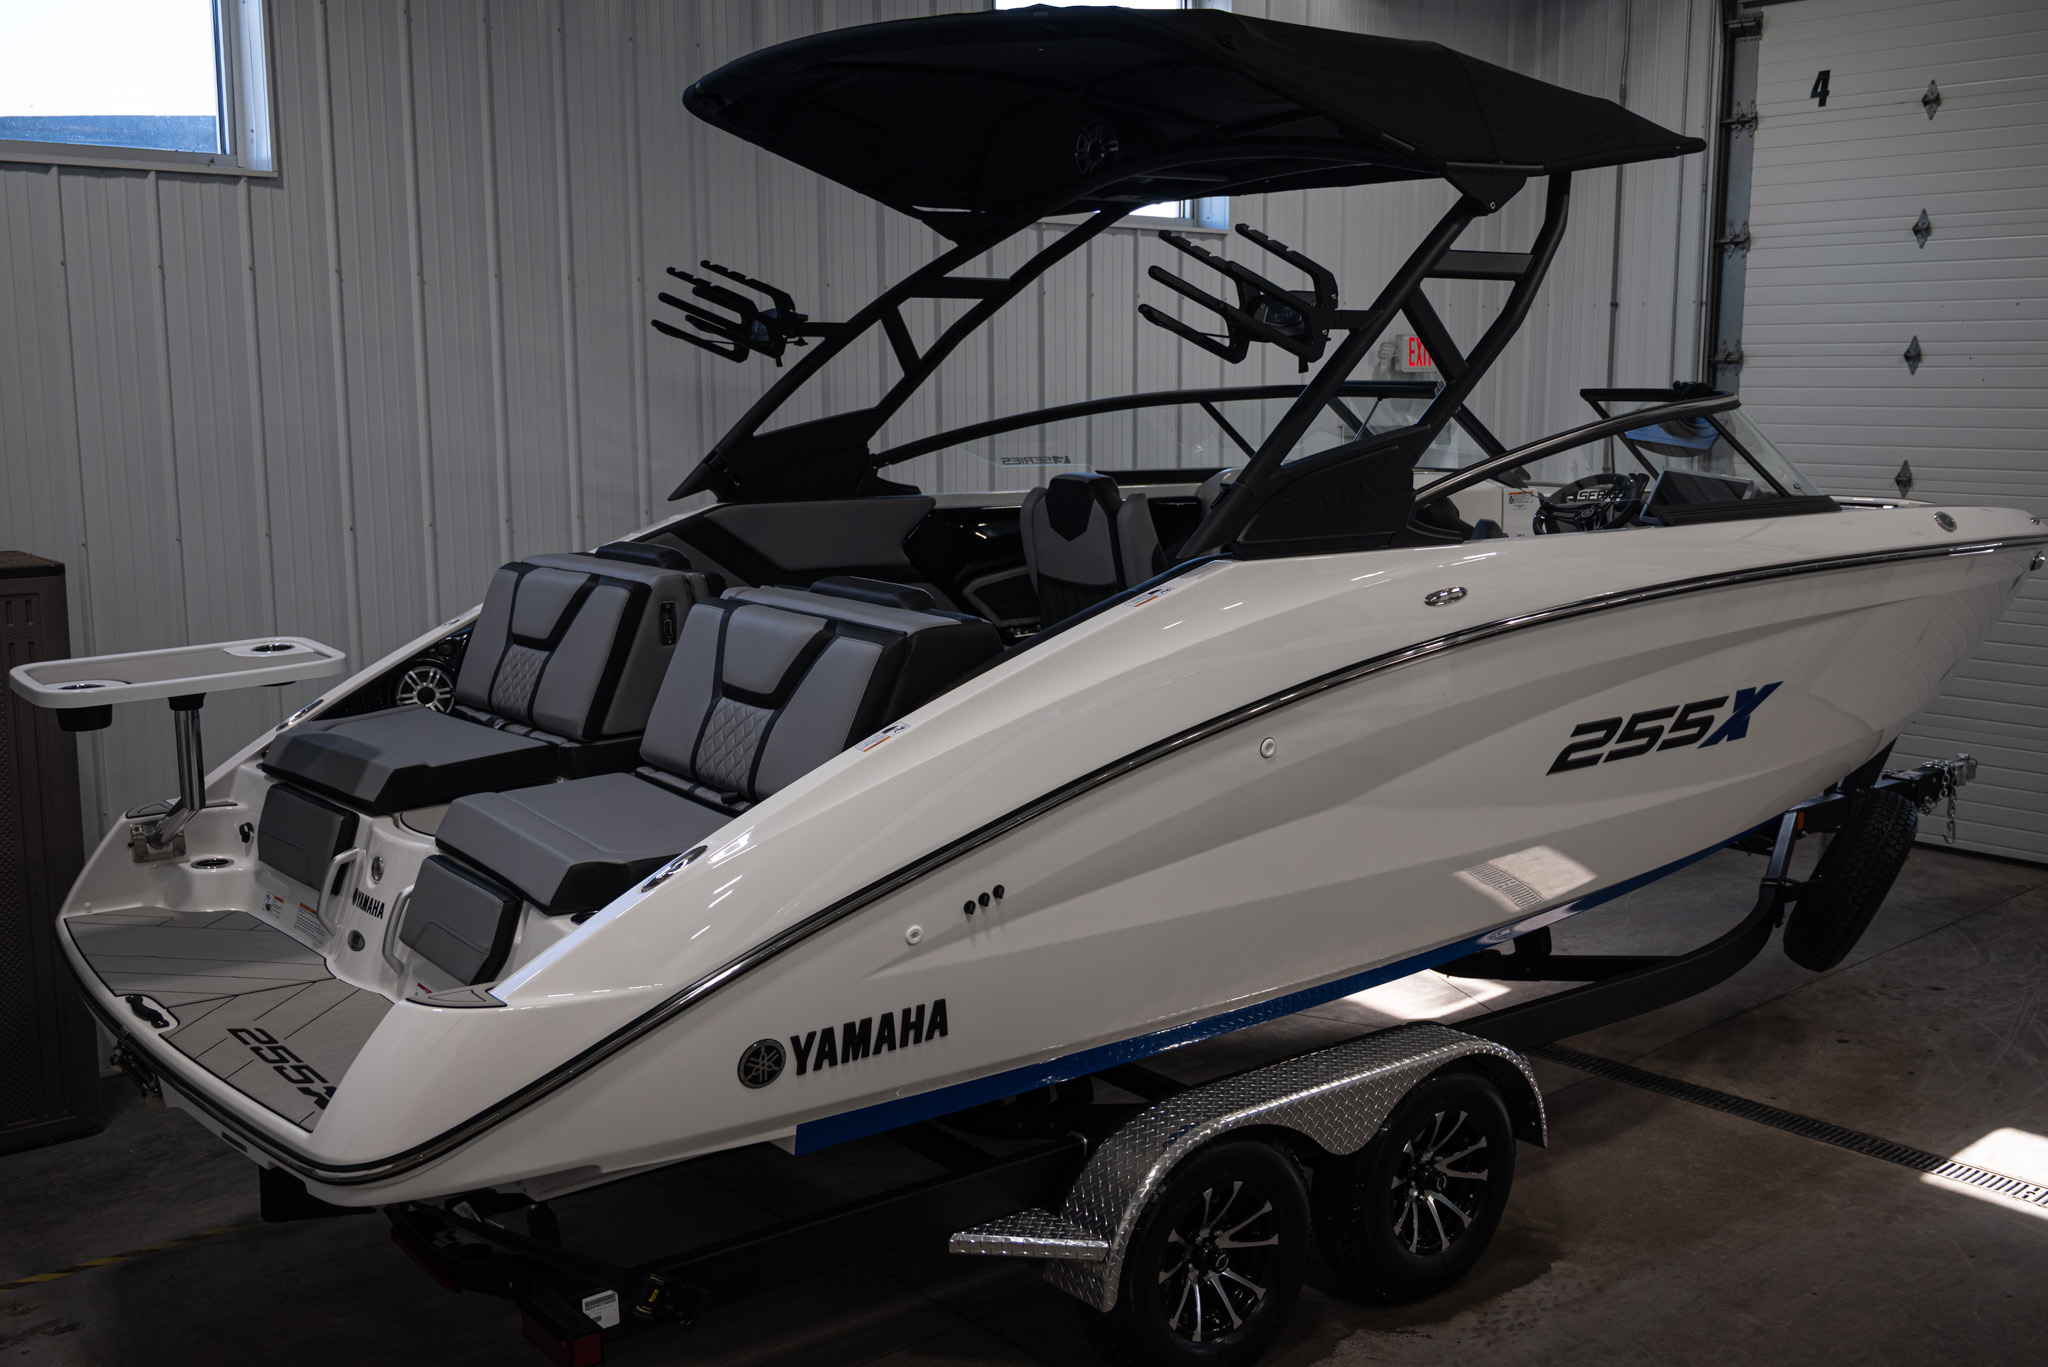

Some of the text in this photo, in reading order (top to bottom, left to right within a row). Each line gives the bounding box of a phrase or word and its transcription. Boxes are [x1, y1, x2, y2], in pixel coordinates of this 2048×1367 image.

[1810, 69, 1830, 107] 4
[1546, 681, 1784, 776] 255X
[357, 890, 385, 919] YAMAHA
[790, 998, 948, 1075] YAMAHA
